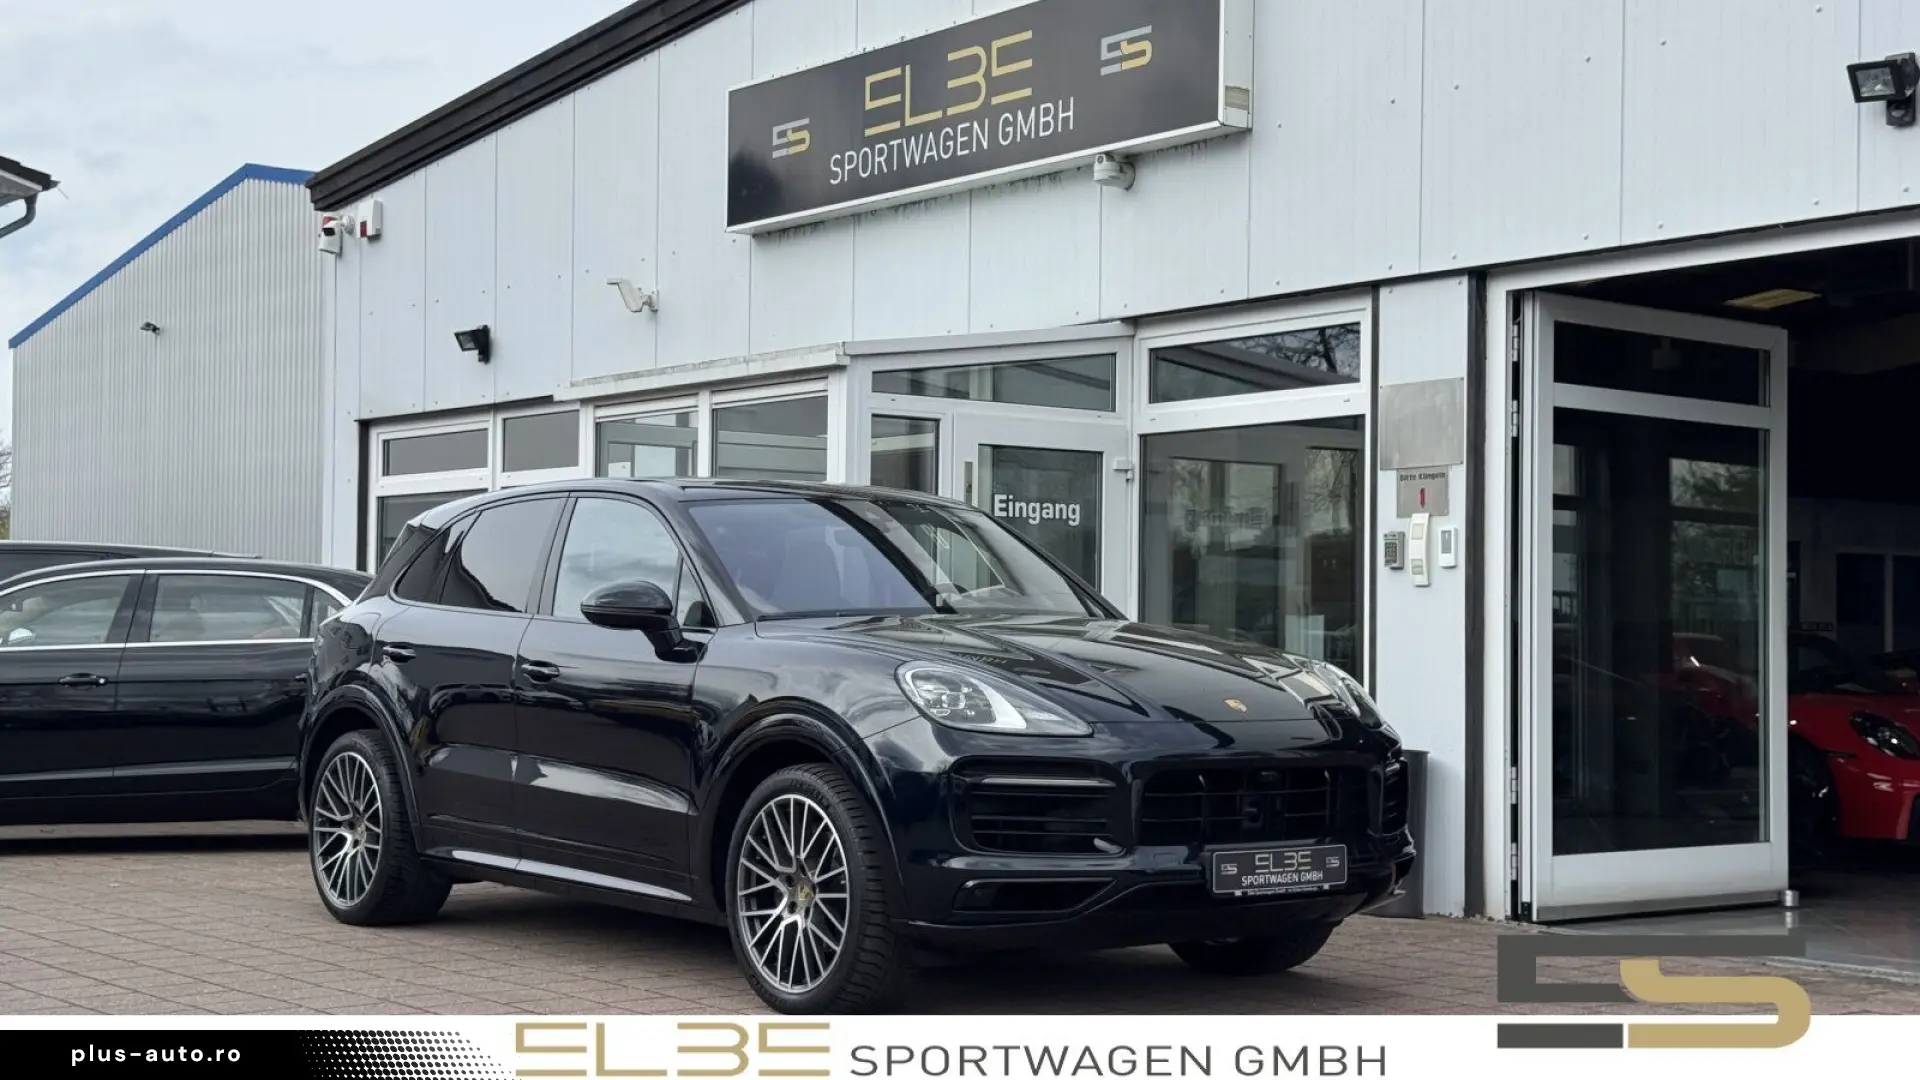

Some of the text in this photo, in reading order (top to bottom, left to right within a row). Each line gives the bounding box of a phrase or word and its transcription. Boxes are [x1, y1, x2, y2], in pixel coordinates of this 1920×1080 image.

[864, 29, 1033, 137] ELBE
[829, 96, 1074, 185] SPORTWAGEN GMBH
[994, 493, 1081, 527] Eingang
[1241, 870, 1323, 887] SPORTWAGEN GMBH
[1255, 851, 1312, 873] ELBE
